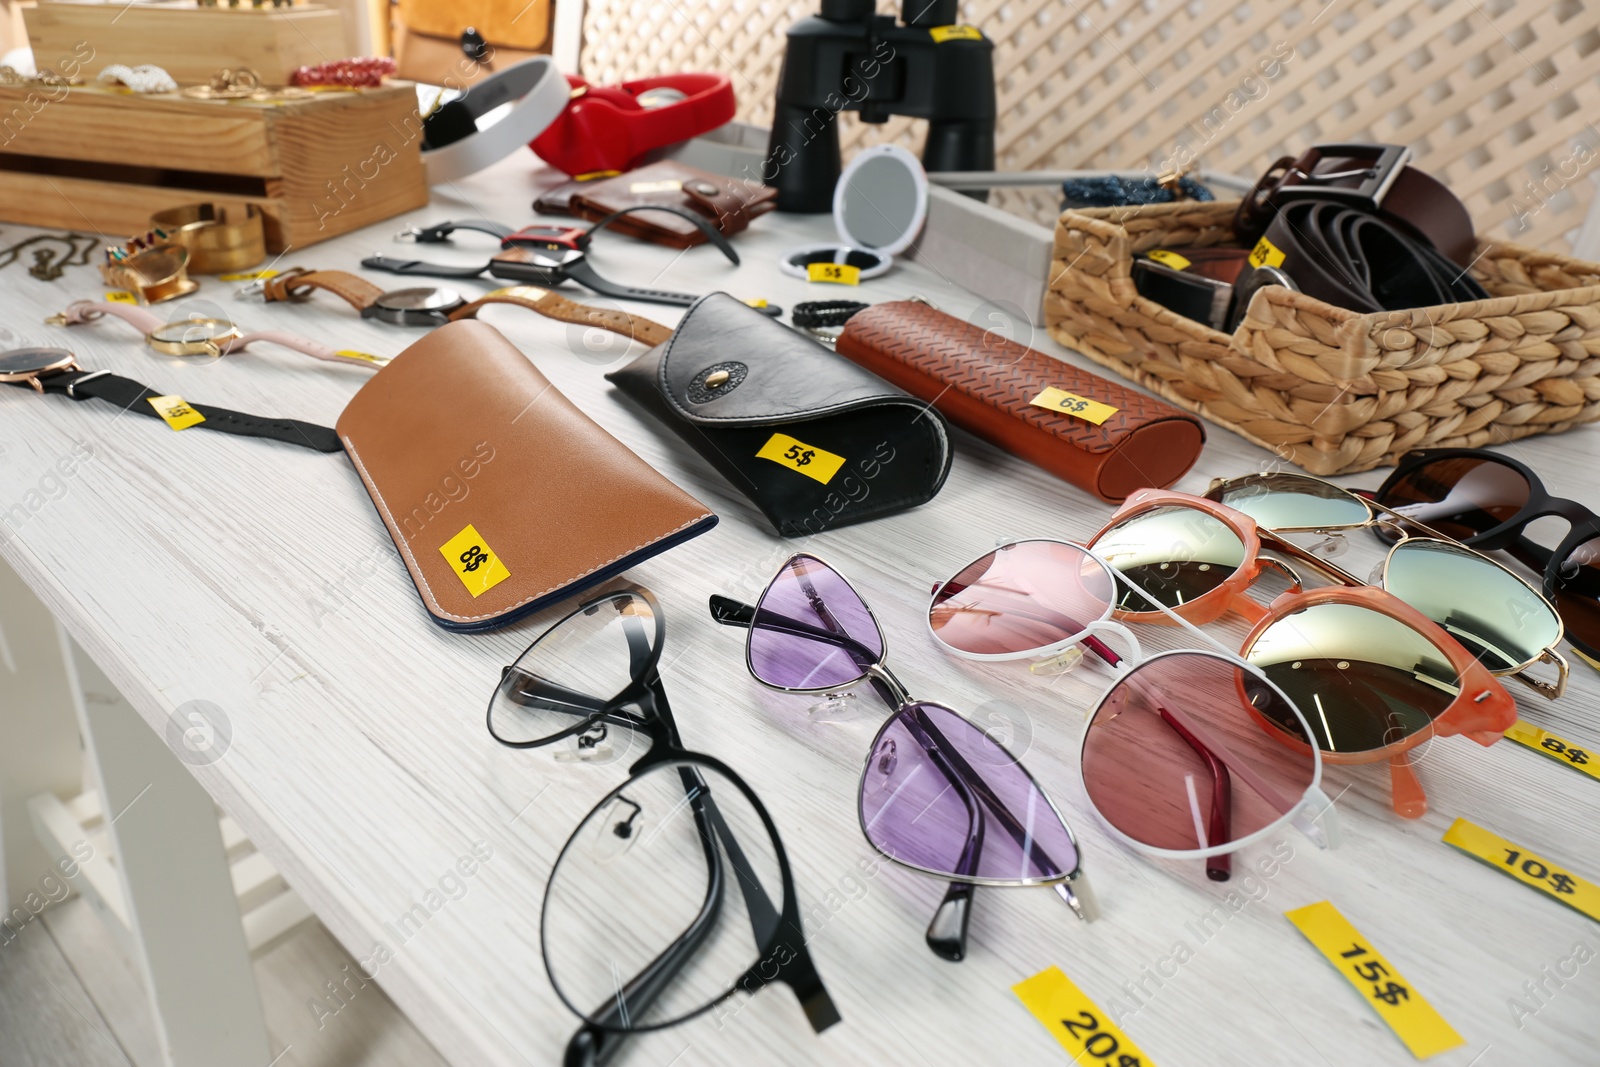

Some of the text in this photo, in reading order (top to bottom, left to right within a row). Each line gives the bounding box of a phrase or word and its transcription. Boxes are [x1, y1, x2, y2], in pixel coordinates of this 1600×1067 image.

[1059, 397, 1089, 412] 6$
[784, 445, 816, 467] 5$
[460, 545, 488, 573] 8$
[1540, 738, 1589, 765] 8$
[1504, 848, 1577, 894] 10$
[1340, 943, 1410, 1006] 15$
